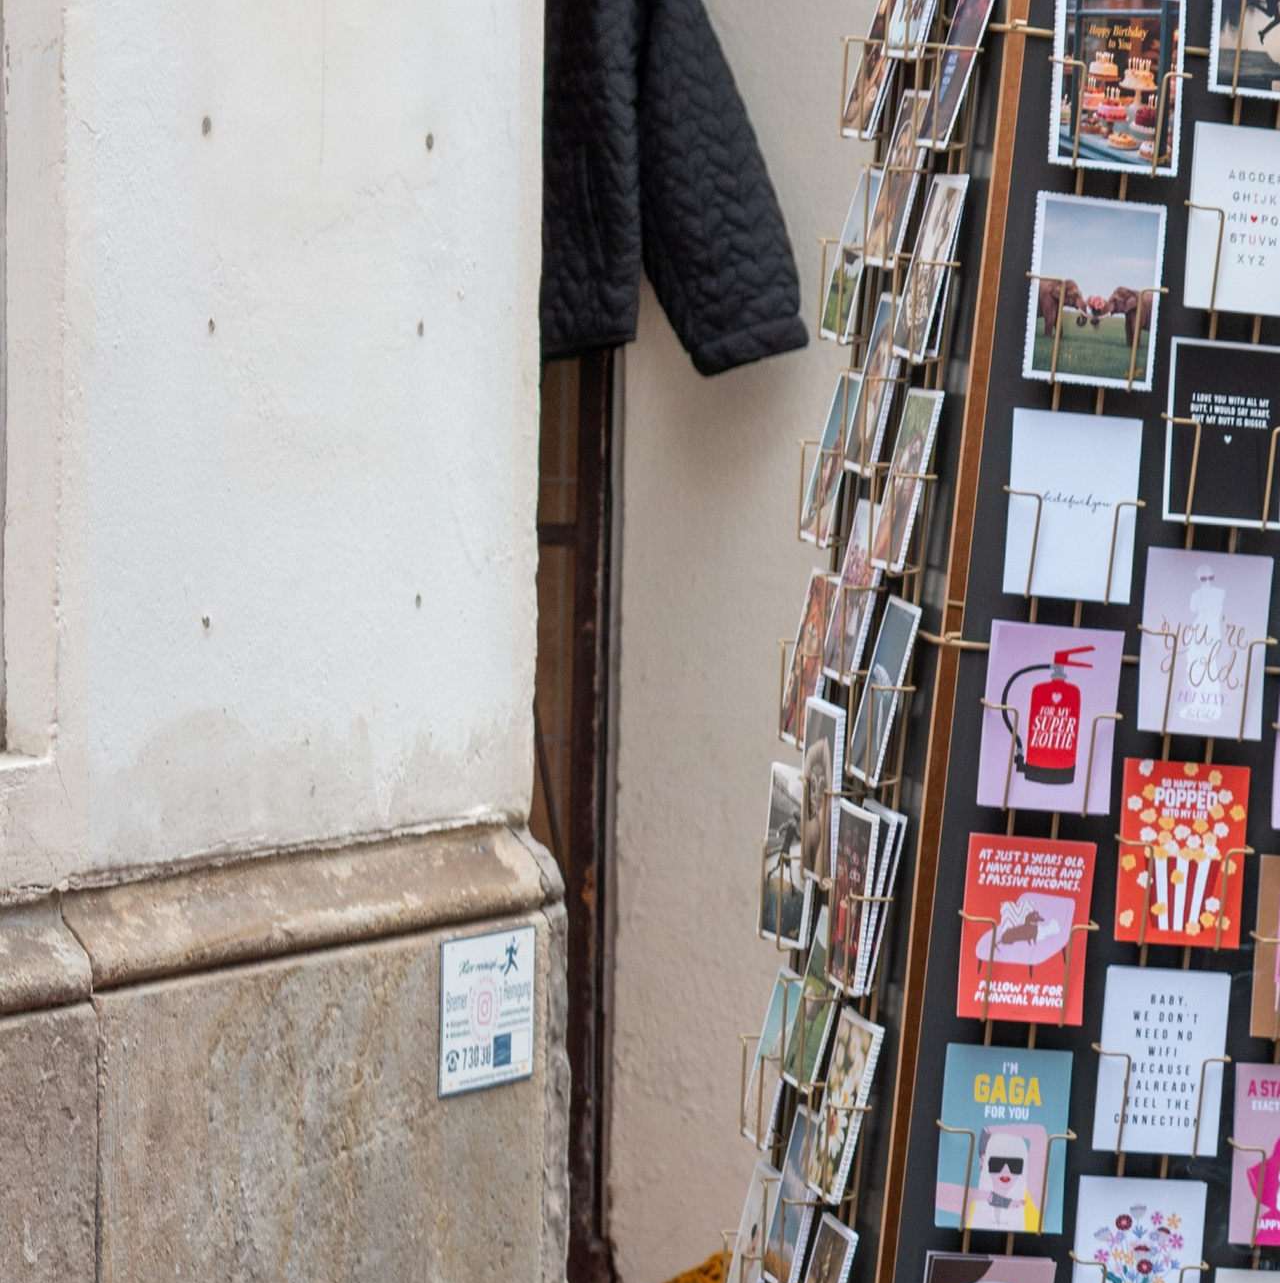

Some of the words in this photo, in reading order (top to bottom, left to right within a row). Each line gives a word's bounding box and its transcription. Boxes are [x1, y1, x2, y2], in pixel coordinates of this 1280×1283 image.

[1089, 24, 1111, 38] Happy
[1113, 24, 1148, 41] Birthday
[1108, 39, 1116, 48] to
[1119, 38, 1132, 50] You
[1192, 392, 1196, 402] I
[1197, 392, 1212, 403] LOVE
[1214, 394, 1226, 404] YOU
[1228, 395, 1245, 406] WITH
[1246, 397, 1257, 407] ALL
[1259, 398, 1270, 408] MY
[1209, 405, 1213, 413] I
[1214, 405, 1235, 415] WOULD
[1237, 407, 1248, 416] SAY
[1191, 414, 1204, 423] BUT
[1206, 414, 1216, 424] MY
[1218, 416, 1235, 426] BUTT
[1236, 417, 1243, 427] IS
[1160, 614, 1248, 674] you're
[1040, 706, 1055, 715] FOR
[1058, 707, 1071, 717] MY
[1032, 716, 1076, 733] SUPER
[1162, 778, 1172, 787] SO
[1174, 780, 1196, 789] HAPPY
[1198, 781, 1212, 790] YOU
[1154, 787, 1218, 810] POPPED
[1162, 808, 1179, 817] INTO
[1181, 808, 1191, 818] MY
[1193, 810, 1208, 820] LIFE
[979, 849, 992, 859] AT
[996, 850, 1021, 861] JUST
[1023, 853, 1029, 862] 3
[1031, 853, 1062, 866] YEARS
[979, 861, 983, 871] I
[986, 863, 1011, 874] HAVE
[1014, 865, 1020, 874] A
[1025, 865, 1057, 877] HOUSE
[1060, 868, 1083, 879] AND
[978, 875, 986, 885] 2
[987, 875, 1028, 887] PASSIVE
[1024, 983, 1040, 994] ME
[1042, 985, 1063, 996] FOR
[446, 991, 467, 1013] Bremer
[504, 981, 531, 1003] Reinigung
[1133, 1011, 1149, 1021] WE
[1159, 1012, 1198, 1024] DON'T
[1136, 1028, 1168, 1039] NEED
[1178, 1030, 1193, 1040] NO
[1148, 1046, 1177, 1057] WIFI
[1003, 1062, 1018, 1074] I'M
[1131, 1063, 1190, 1075] BECAUSE
[974, 1074, 1042, 1106] GAGA
[1136, 1081, 1196, 1093] ALREADY
[1248, 1080, 1257, 1096] A
[1126, 1097, 1156, 1108] FEEL
[1167, 1099, 1189, 1110] THE
[984, 1105, 1005, 1118] FOR
[1009, 1106, 1029, 1120] YOU
